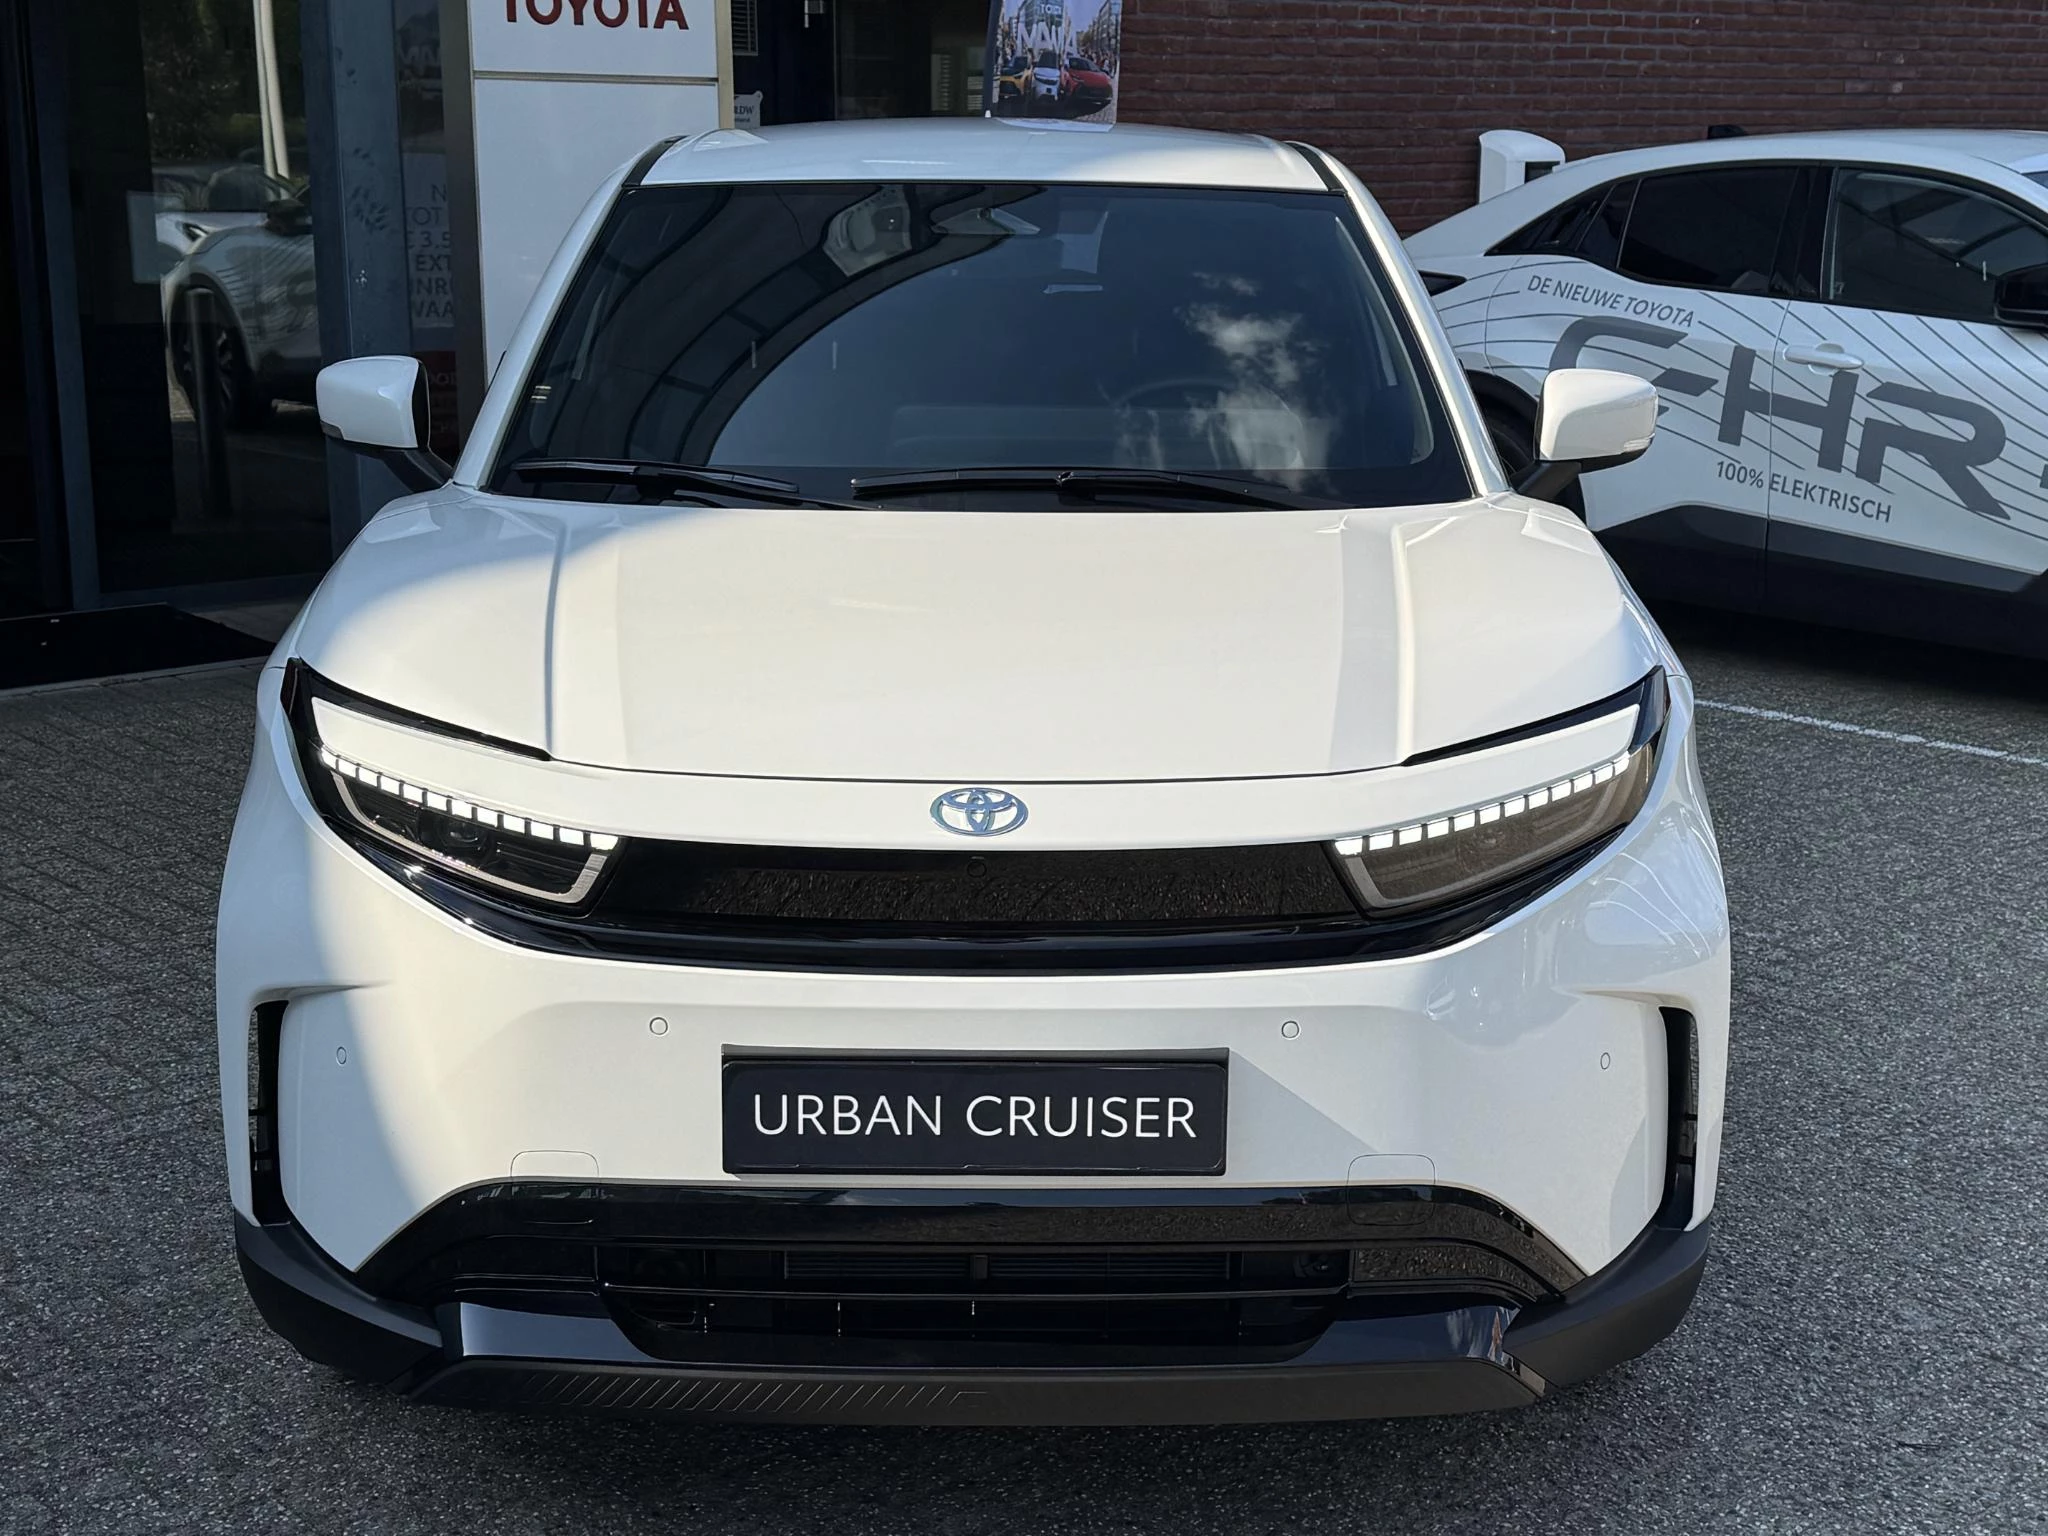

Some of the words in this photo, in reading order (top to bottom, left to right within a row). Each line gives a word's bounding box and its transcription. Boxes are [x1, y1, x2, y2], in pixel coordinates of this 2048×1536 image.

[1526, 274, 1553, 295] DE
[1552, 280, 1624, 311] NIEUWE
[1623, 296, 1695, 328] TOYOTA
[1716, 460, 1764, 489] 100%
[1769, 472, 1893, 524] ELEKTRISCH
[753, 1094, 942, 1137] URBAN
[965, 1095, 1198, 1139] CRUISER
